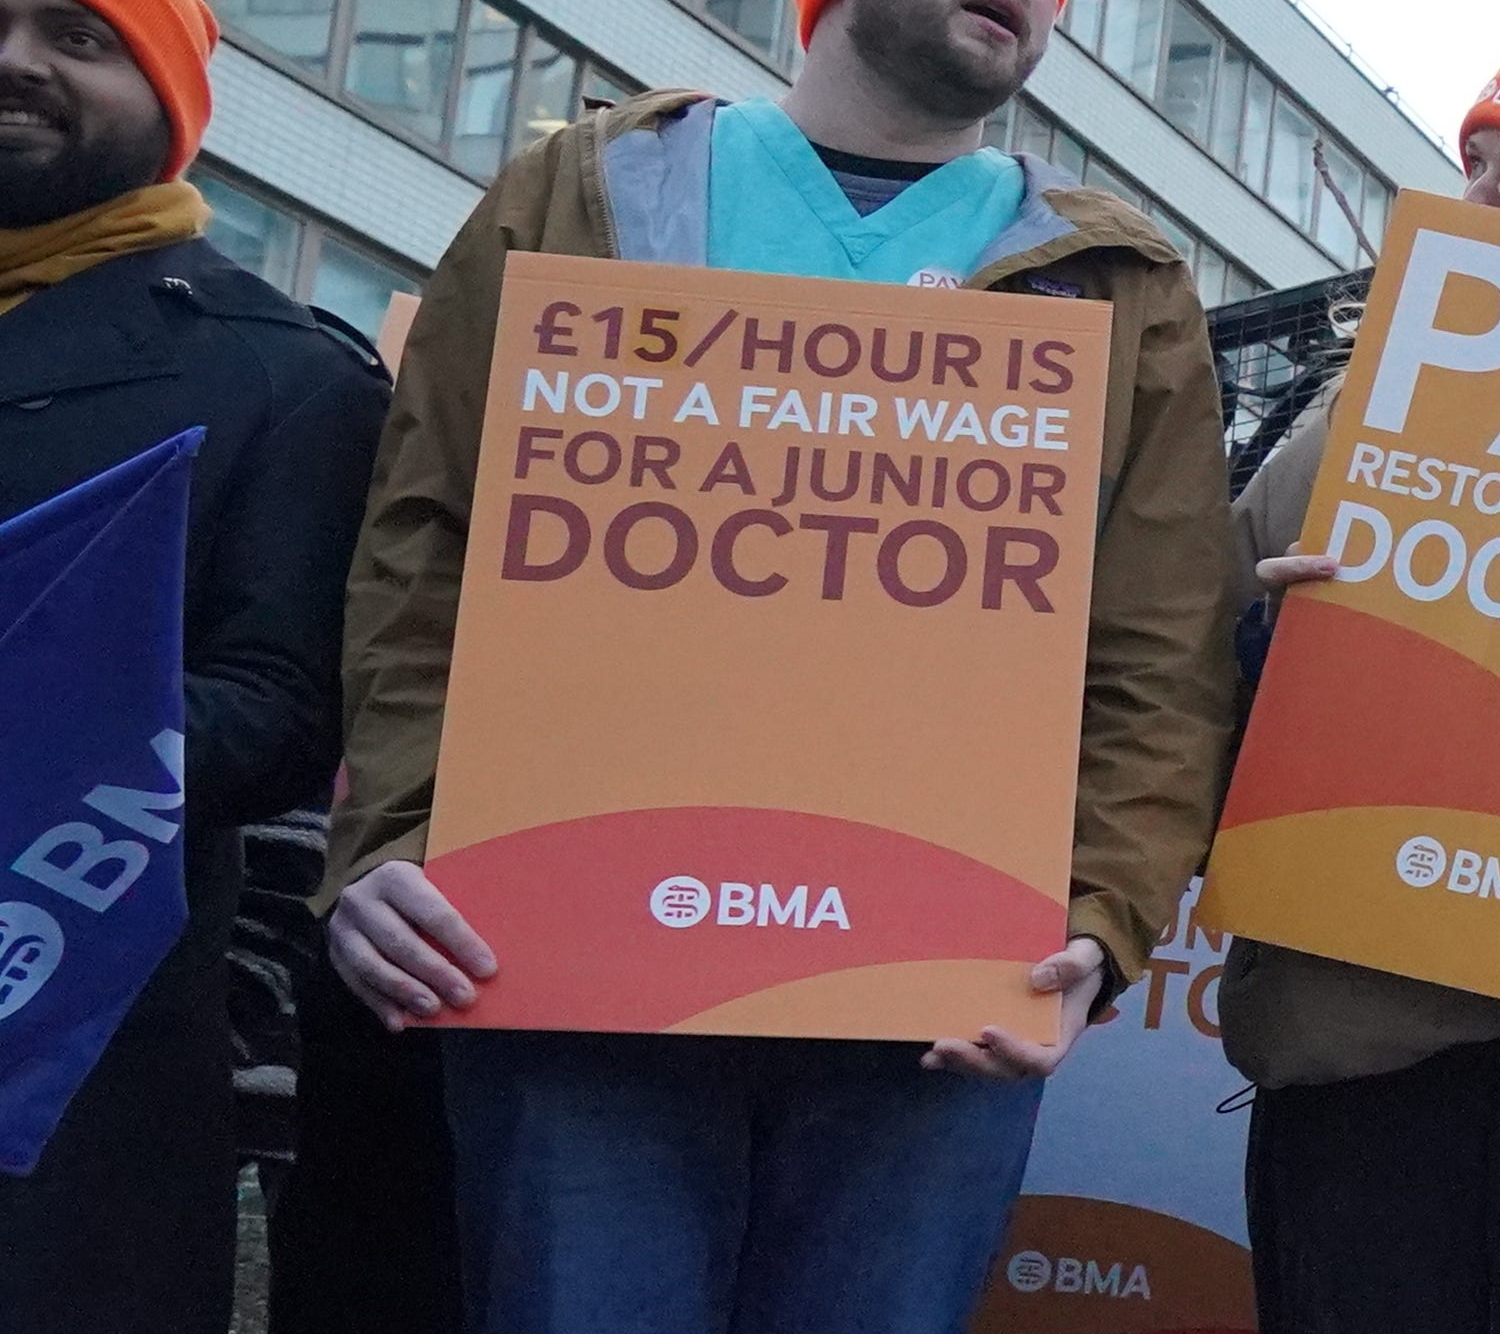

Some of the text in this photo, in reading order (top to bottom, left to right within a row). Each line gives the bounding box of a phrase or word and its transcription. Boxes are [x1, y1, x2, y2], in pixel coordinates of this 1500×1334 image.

[533, 302, 1075, 394] £15/HOUR IS
[519, 367, 1071, 452] NOT A FAIR WAGE
[515, 426, 1066, 516] FOR A JUNIOR
[500, 493, 1061, 613] DOCTOR
[10, 728, 185, 913] BM
[716, 882, 851, 930] BMA
[1054, 1259, 1151, 1300] BMA
